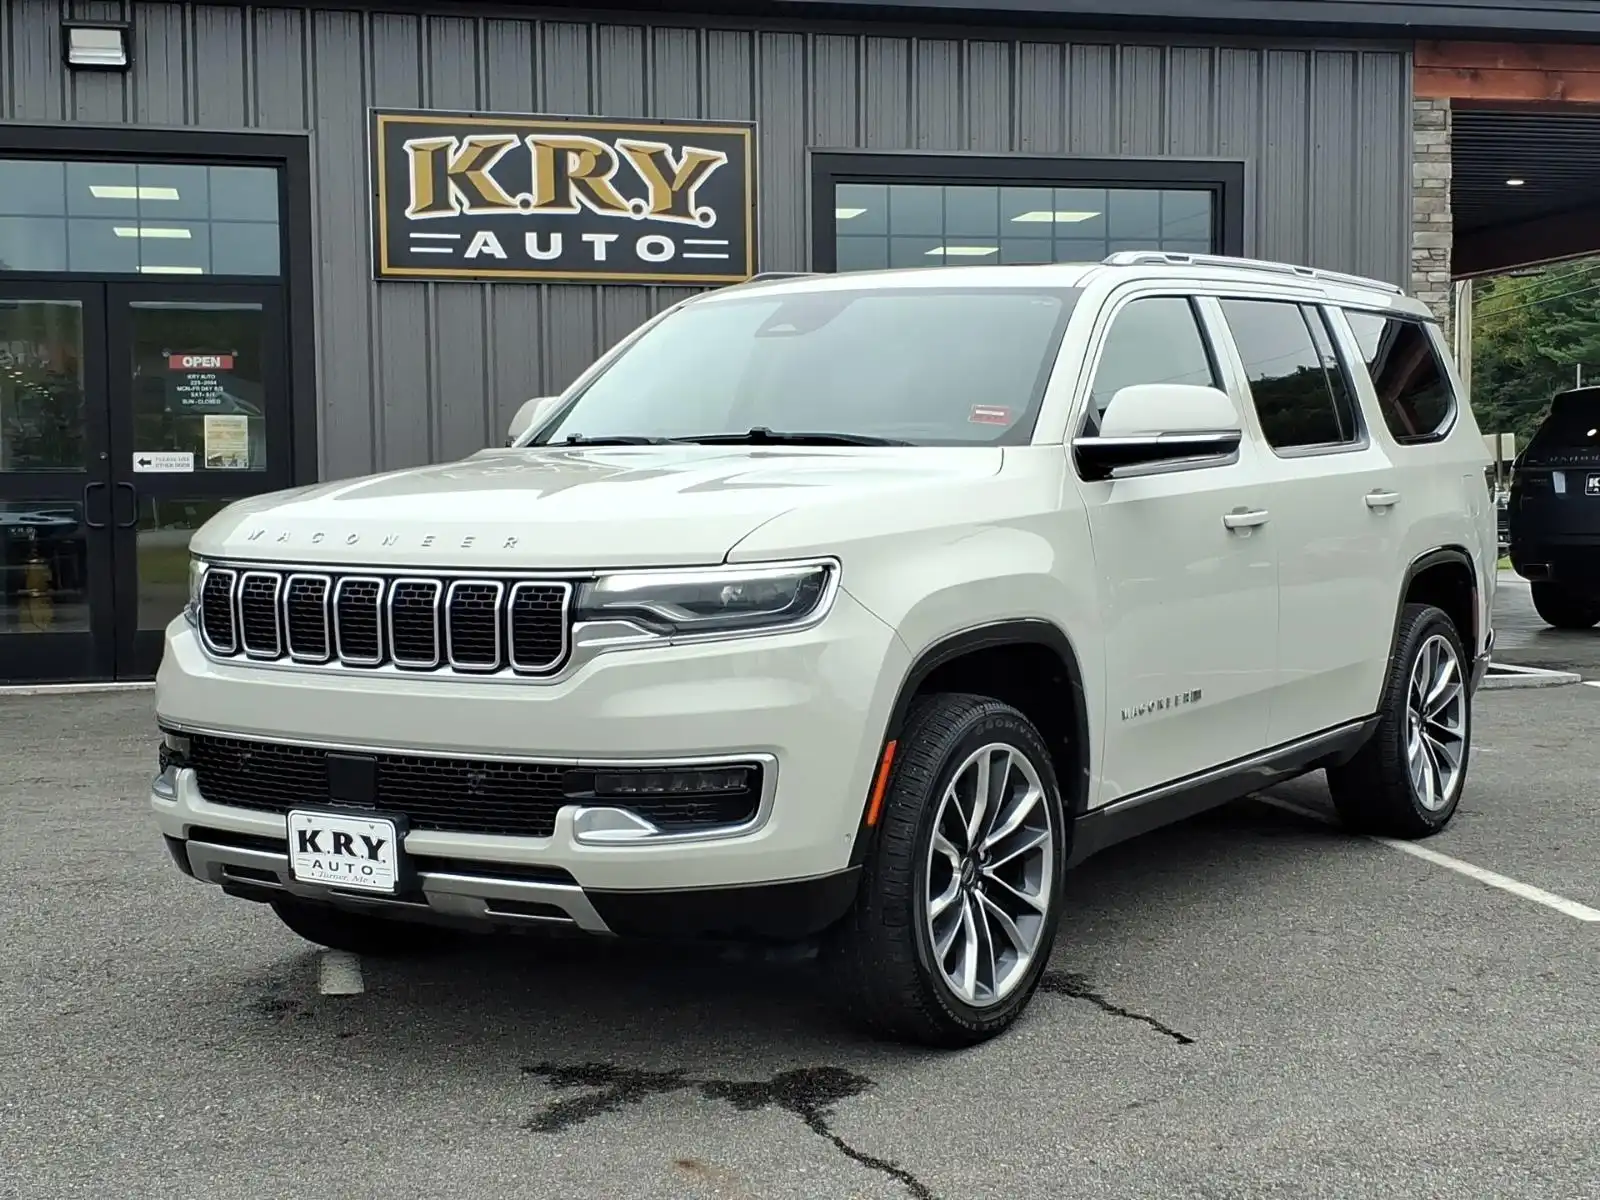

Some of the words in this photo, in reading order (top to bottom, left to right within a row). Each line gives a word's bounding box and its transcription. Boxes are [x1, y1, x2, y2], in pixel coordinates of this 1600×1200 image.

[464, 231, 675, 261] AUTO
[182, 356, 221, 368] OPEN
[248, 529, 519, 548] WAGONEER
[312, 859, 374, 876] AUTO
